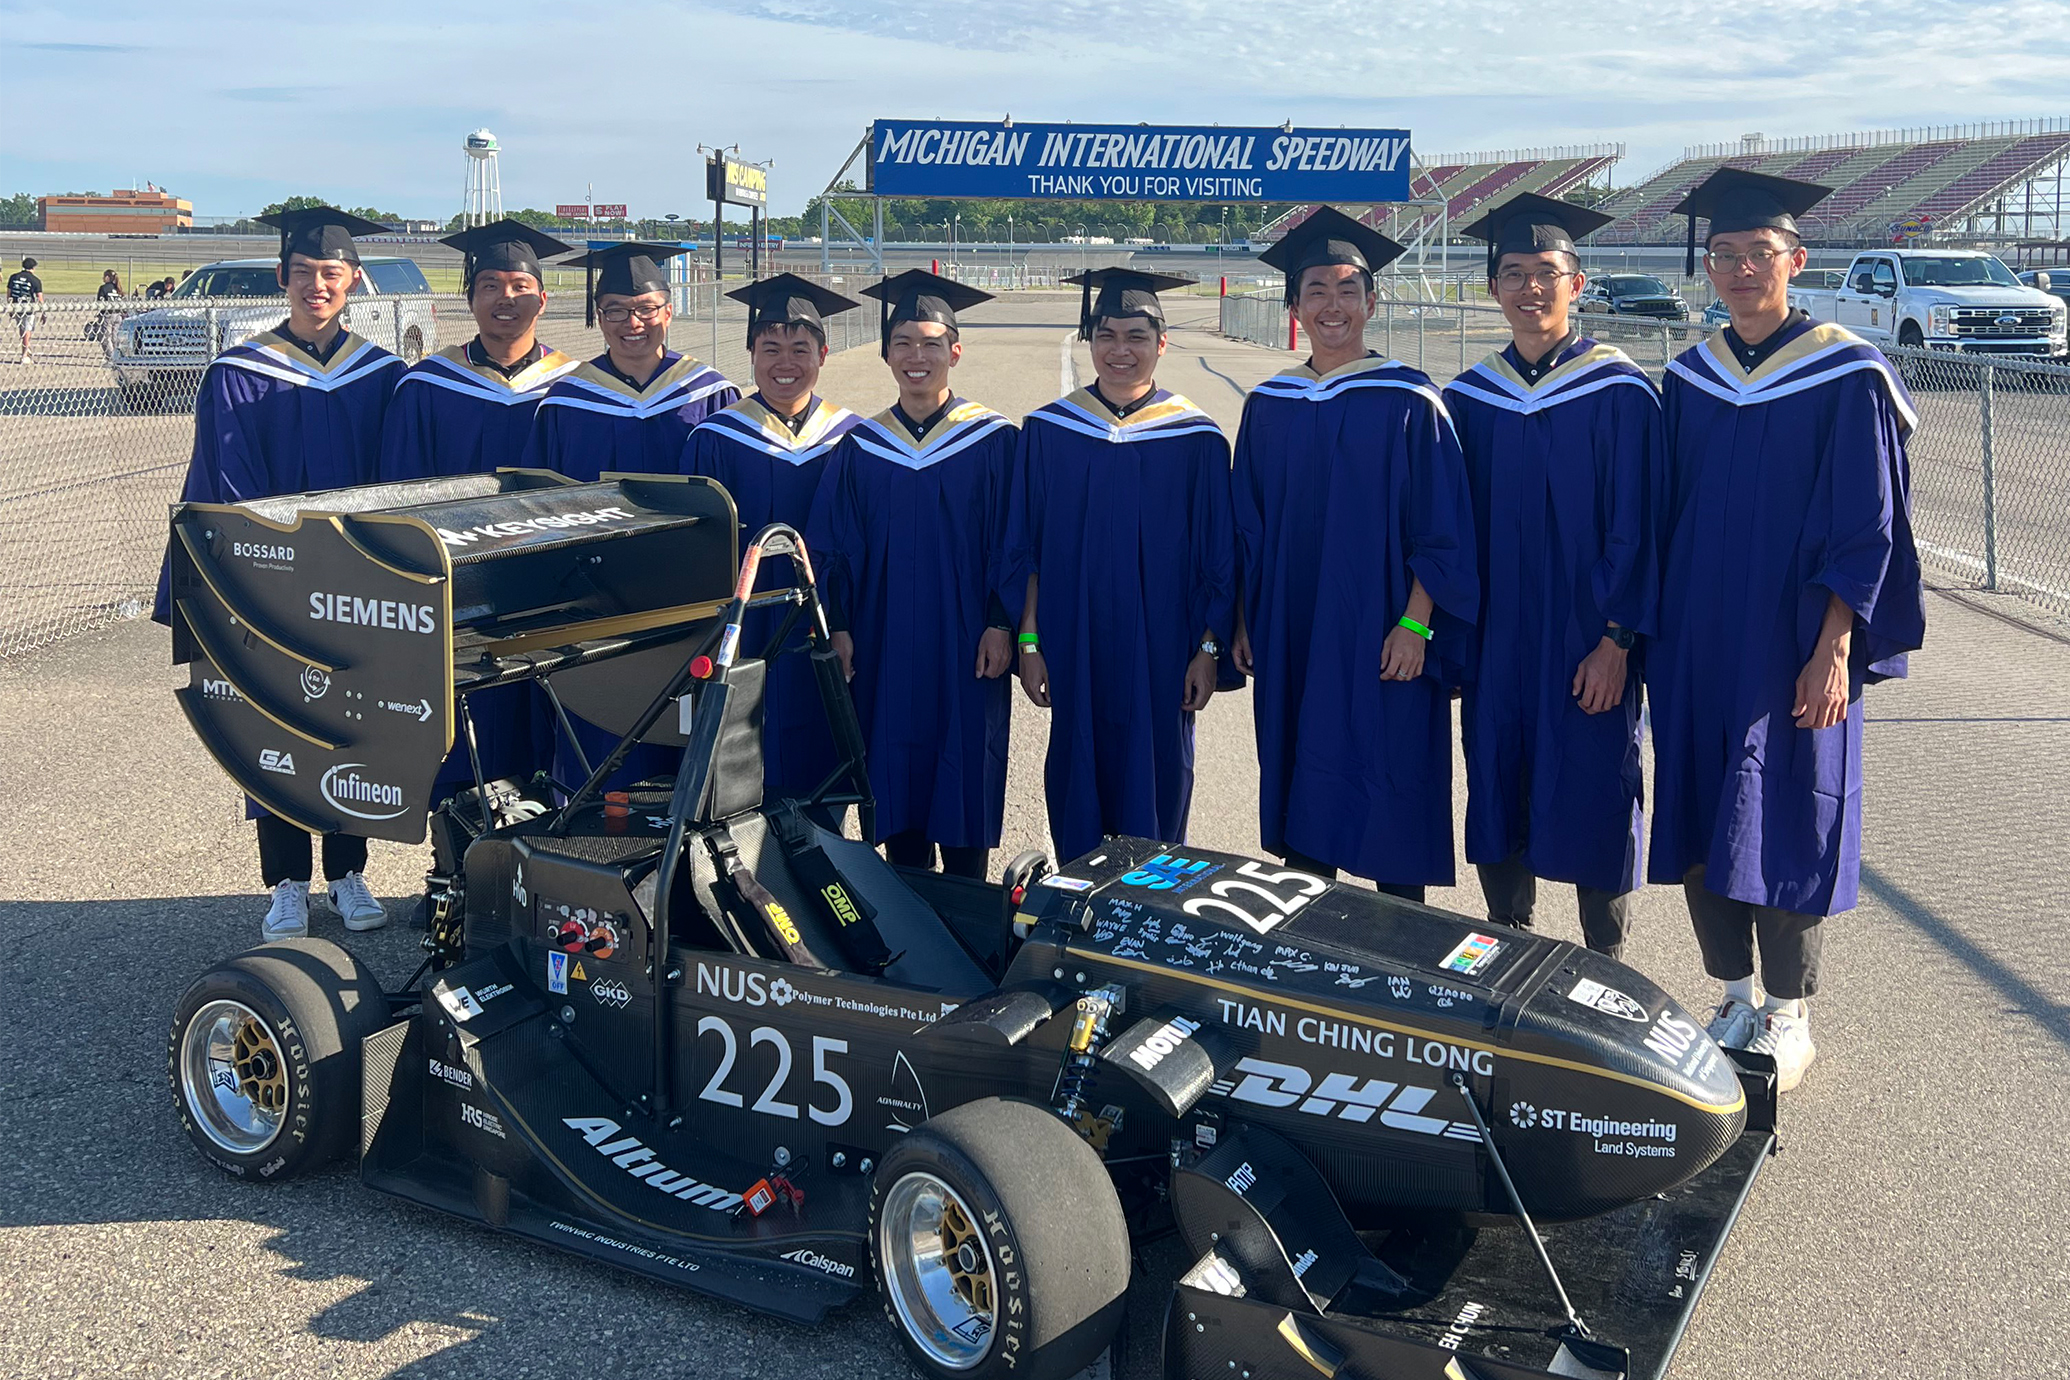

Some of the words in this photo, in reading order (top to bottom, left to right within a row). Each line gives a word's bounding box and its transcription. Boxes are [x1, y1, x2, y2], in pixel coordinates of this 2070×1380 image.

[876, 128, 1031, 167] MICHIGAN
[1037, 132, 1256, 169] INTERNATIONAL
[1266, 136, 1410, 172] SPEEDWAY
[1028, 175, 1094, 194] THANK
[1100, 176, 1139, 195] YOU
[1145, 176, 1180, 195] FOR
[1185, 177, 1263, 197] VISITING
[1893, 224, 1930, 233] SUNOCO
[474, 506, 635, 539] KEYSIGHT
[233, 542, 295, 561] BOSSARD
[253, 562, 267, 570] Proven
[268, 563, 295, 572] Productivity
[309, 591, 435, 635] SIEMENS
[387, 700, 422, 715] wenext
[259, 749, 295, 770] GA
[1121, 854, 1210, 890] SAE
[826, 884, 857, 923] OMP
[1183, 861, 1326, 935] 225
[768, 902, 801, 944] OMP
[551, 981, 564, 991] OFF
[594, 985, 628, 1001] GKD
[697, 962, 767, 1007] NUS
[792, 989, 833, 1007] Polymer
[835, 996, 899, 1018] Technologies
[900, 1007, 917, 1020] Pte
[918, 1009, 937, 1023] Ltd
[1129, 1015, 1202, 1071] MOTUL
[1217, 998, 1287, 1037] TIAN
[1297, 1017, 1395, 1059] CHING
[1406, 1037, 1494, 1077] LONG
[1643, 1009, 1698, 1067] NUS
[275, 1016, 310, 1144] Hoosier
[443, 1064, 472, 1087] BENDER
[697, 1015, 853, 1127] 225
[876, 1096, 924, 1111] ADMIRALTY
[1230, 1056, 1451, 1136] DHL
[461, 1102, 483, 1129] HRS
[1541, 1108, 1566, 1130] ST
[1570, 1111, 1677, 1142] Engineering
[561, 1117, 746, 1211] Altium
[1594, 1139, 1623, 1155] Land
[1625, 1142, 1676, 1159] Systems
[549, 1220, 596, 1240] TWINVAC
[594, 1234, 657, 1259] INDUSTRIES
[655, 1253, 680, 1266] PTE
[678, 1260, 701, 1272] LTD
[800, 1250, 855, 1279] Calspan
[982, 1208, 1024, 1370] Hoosier
[1450, 1301, 1485, 1335] CHUN
